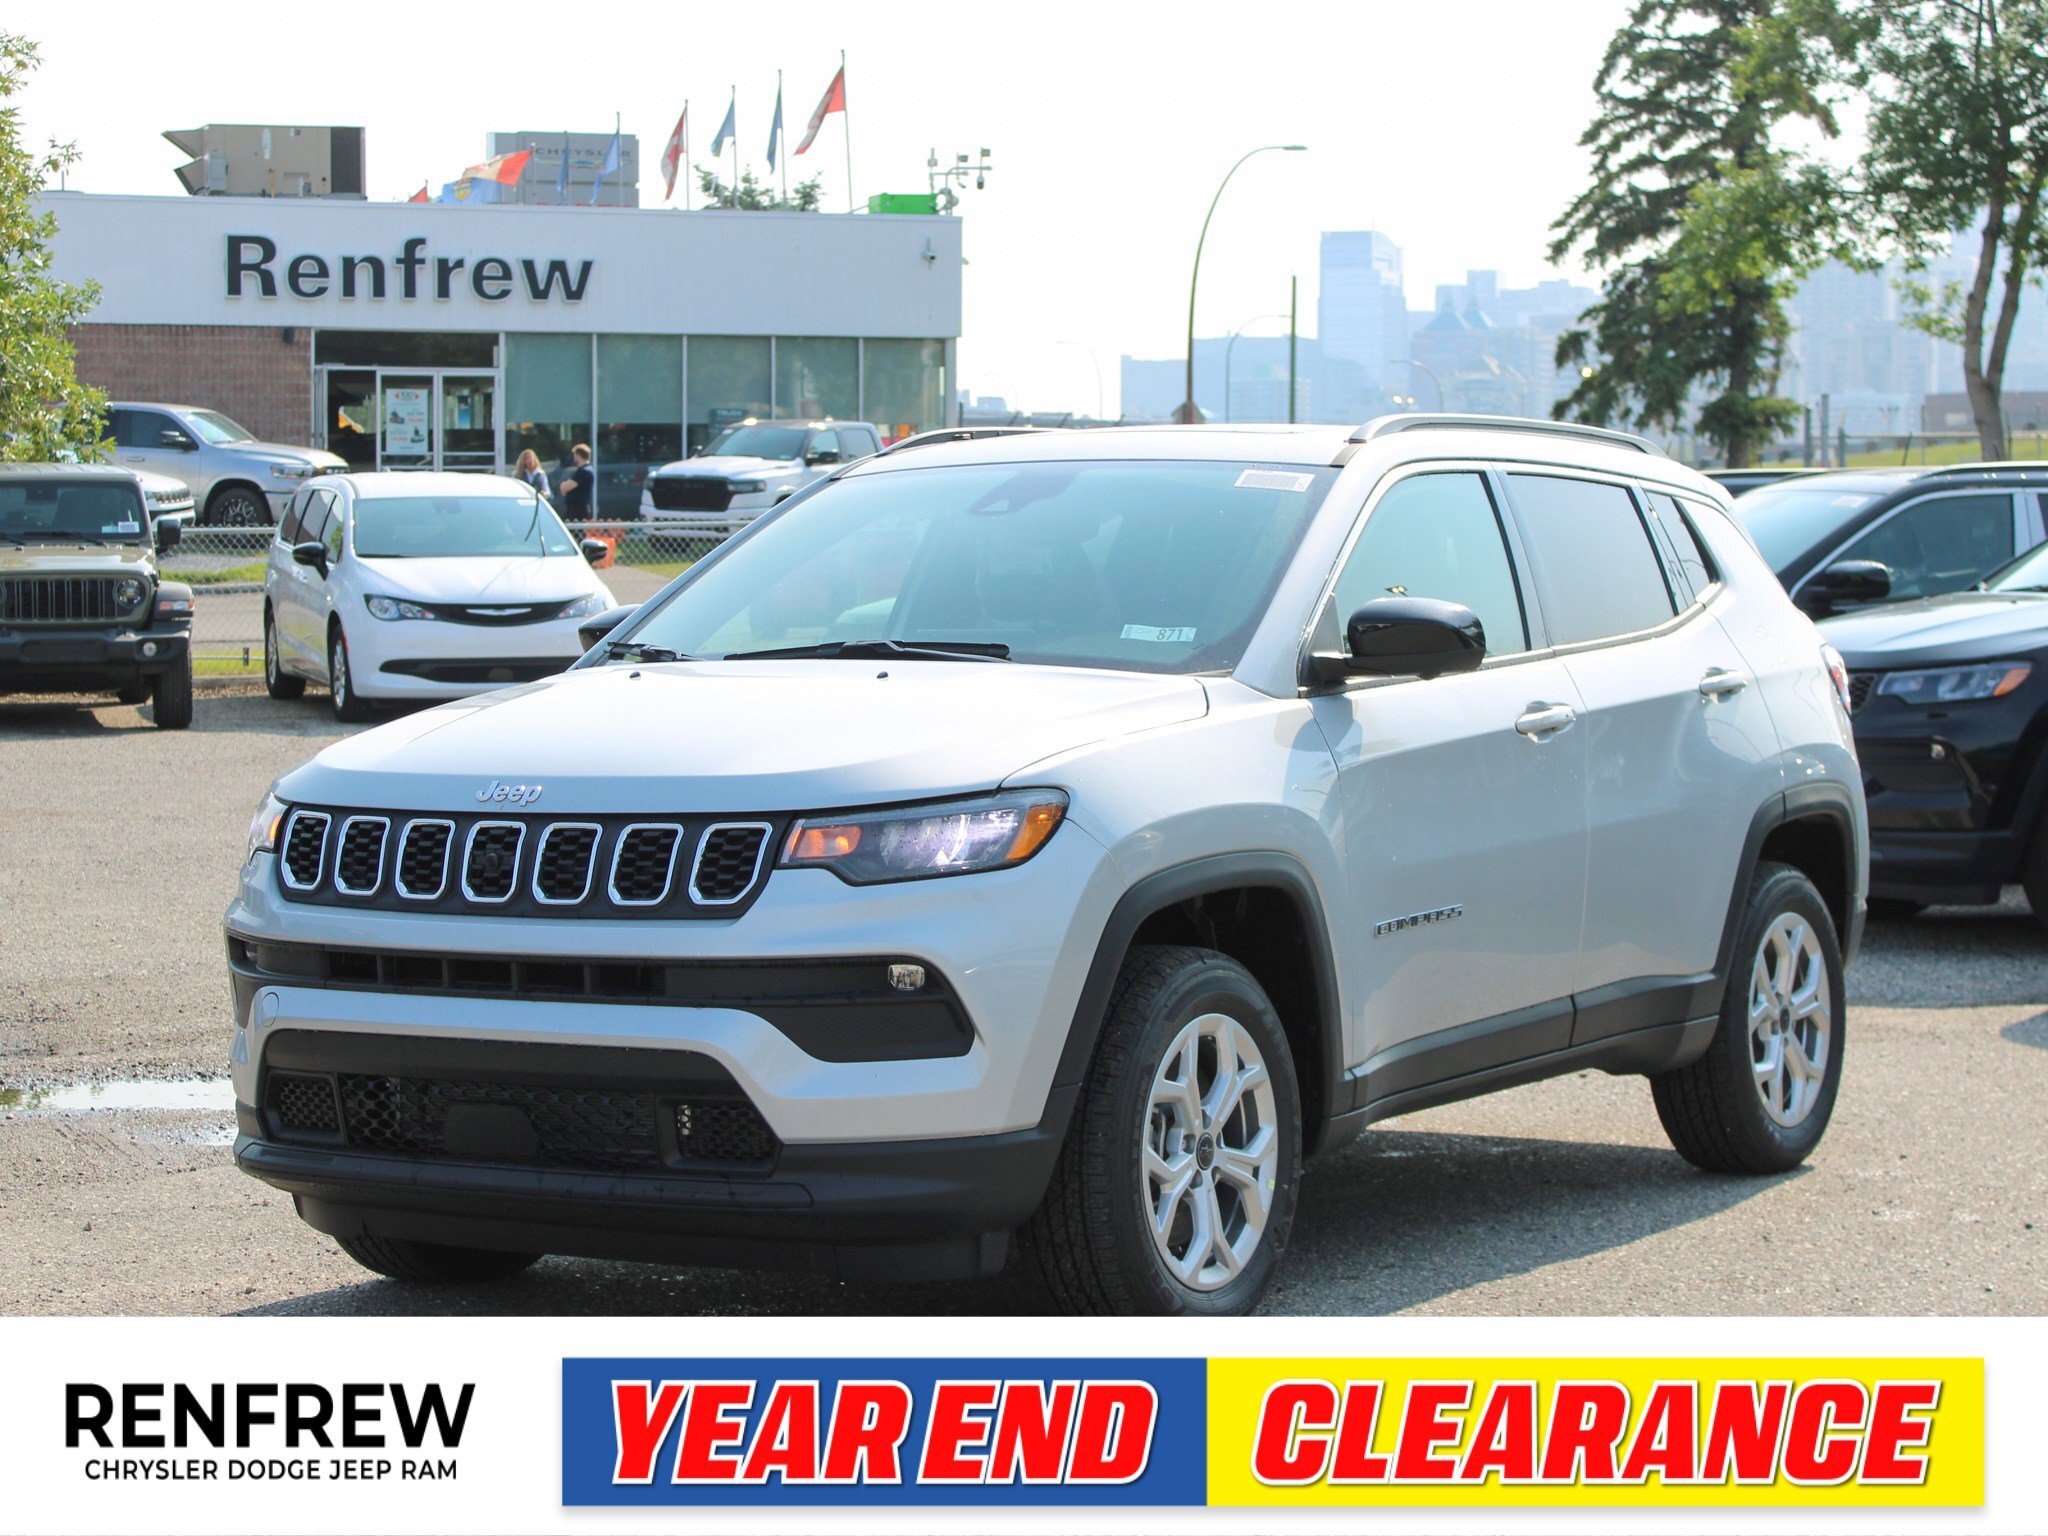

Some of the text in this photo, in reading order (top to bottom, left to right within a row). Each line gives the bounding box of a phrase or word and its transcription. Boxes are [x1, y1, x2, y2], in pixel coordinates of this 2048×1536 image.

[535, 146, 631, 157] CHYSLR
[225, 234, 594, 301] Renfrew
[1156, 628, 1184, 641] 871
[475, 780, 542, 807] Jeep
[1375, 904, 1463, 936] COMPASS
